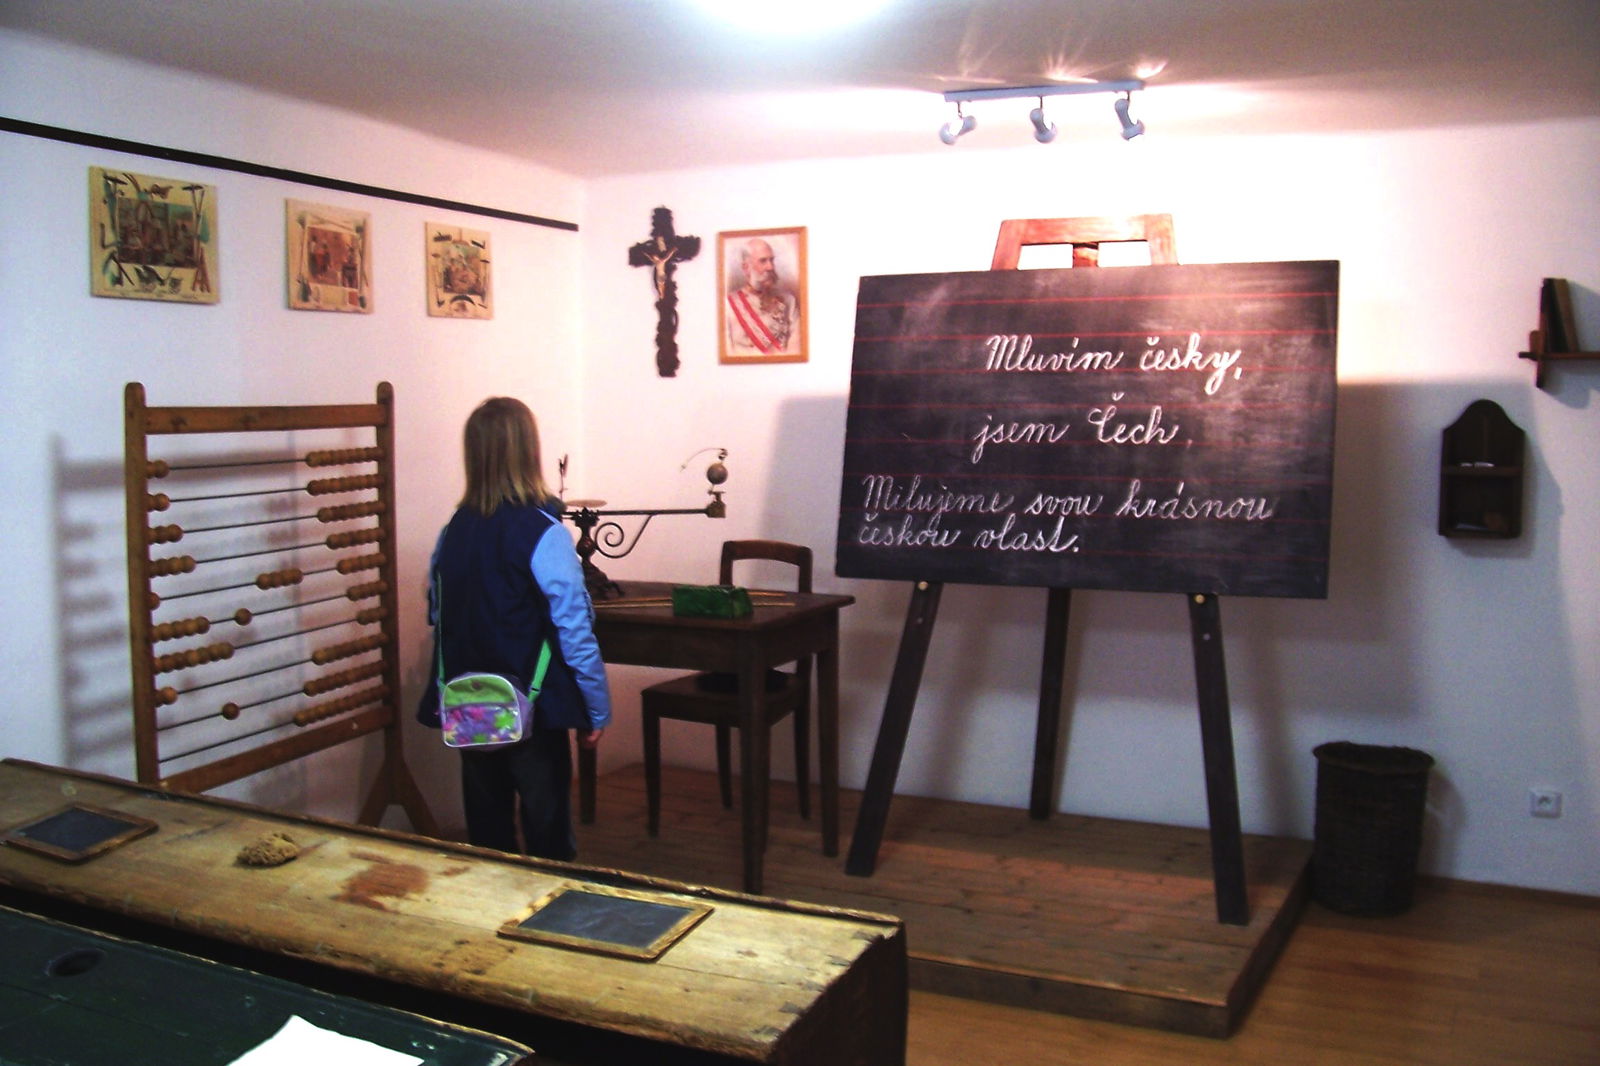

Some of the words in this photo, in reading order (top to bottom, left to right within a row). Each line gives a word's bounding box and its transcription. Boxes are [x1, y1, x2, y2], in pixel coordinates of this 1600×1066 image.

[970, 414, 1071, 465] jsem
[862, 474, 1015, 532] Milujeme
[1024, 492, 1104, 517] svou
[1115, 478, 1277, 521] krásnou
[858, 512, 962, 546] českou
[973, 512, 1081, 553] vlast.
